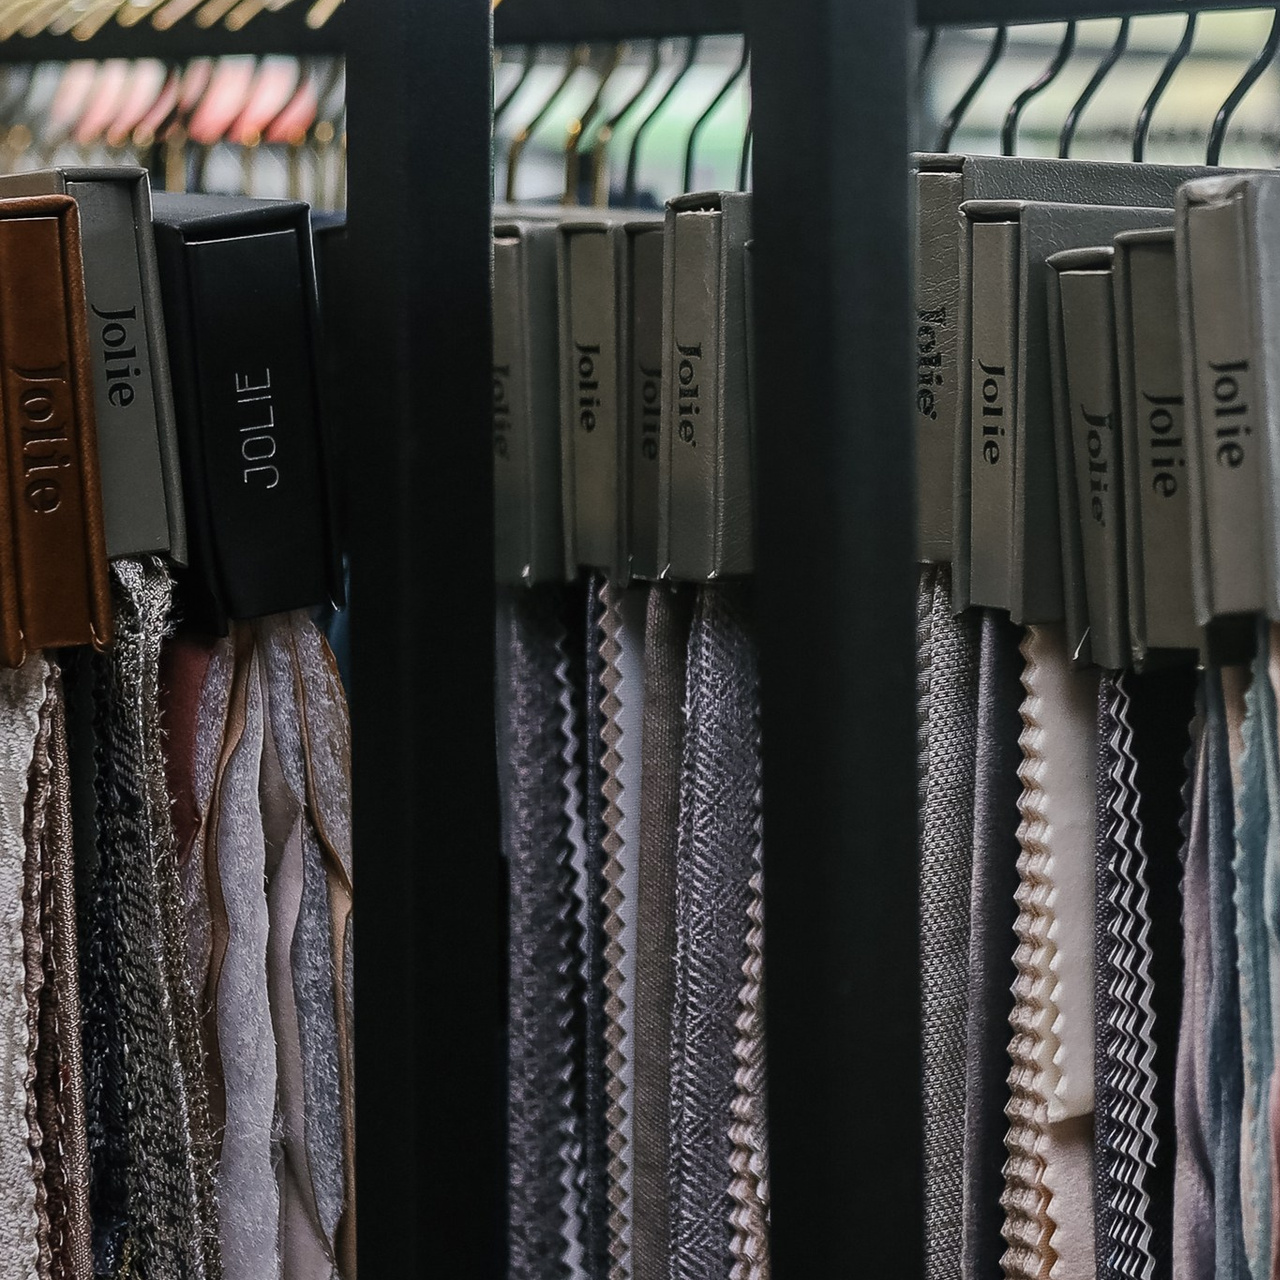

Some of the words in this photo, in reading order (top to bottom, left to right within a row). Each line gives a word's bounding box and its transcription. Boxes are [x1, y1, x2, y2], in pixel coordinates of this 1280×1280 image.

[91, 304, 142, 408] Jolie
[576, 342, 601, 433] Jolie
[12, 361, 71, 514] Jolie
[235, 367, 280, 490] JOLIE
[977, 358, 1005, 465] Jolie
[1143, 391, 1185, 498] Jolie
[1207, 360, 1252, 468] Jolie
